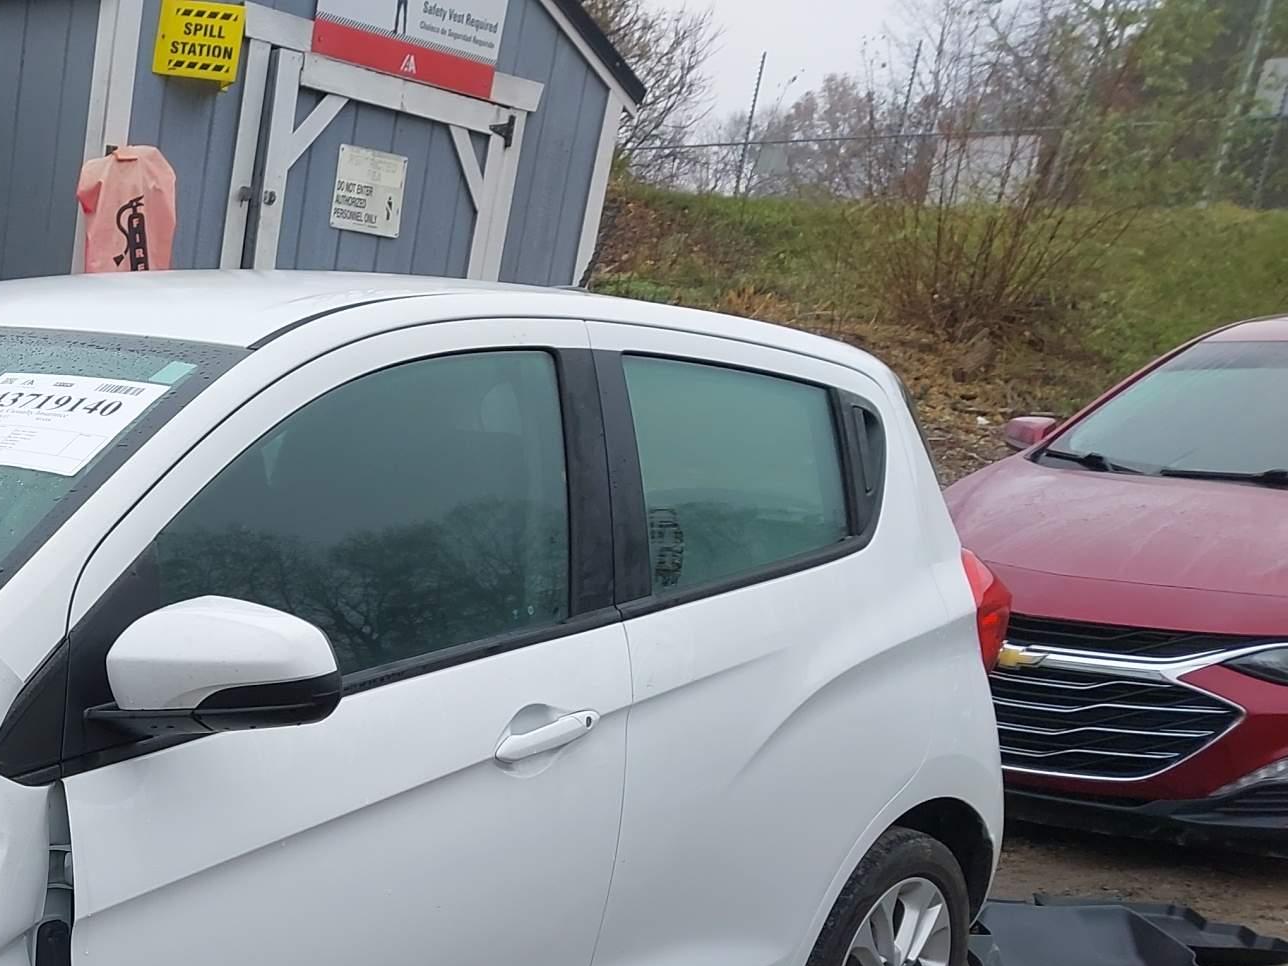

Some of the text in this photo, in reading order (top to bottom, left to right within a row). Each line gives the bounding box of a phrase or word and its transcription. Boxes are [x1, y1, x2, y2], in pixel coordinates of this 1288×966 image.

[422, 1, 499, 34] Safety Vest Required
[183, 22, 226, 39] SPILL
[170, 40, 233, 60] STATION
[337, 180, 374, 197] DO NOT ENTER
[335, 193, 367, 209] AUTHORIZED
[333, 207, 364, 223] PERSONNEL
[364, 212, 378, 225] ONLY
